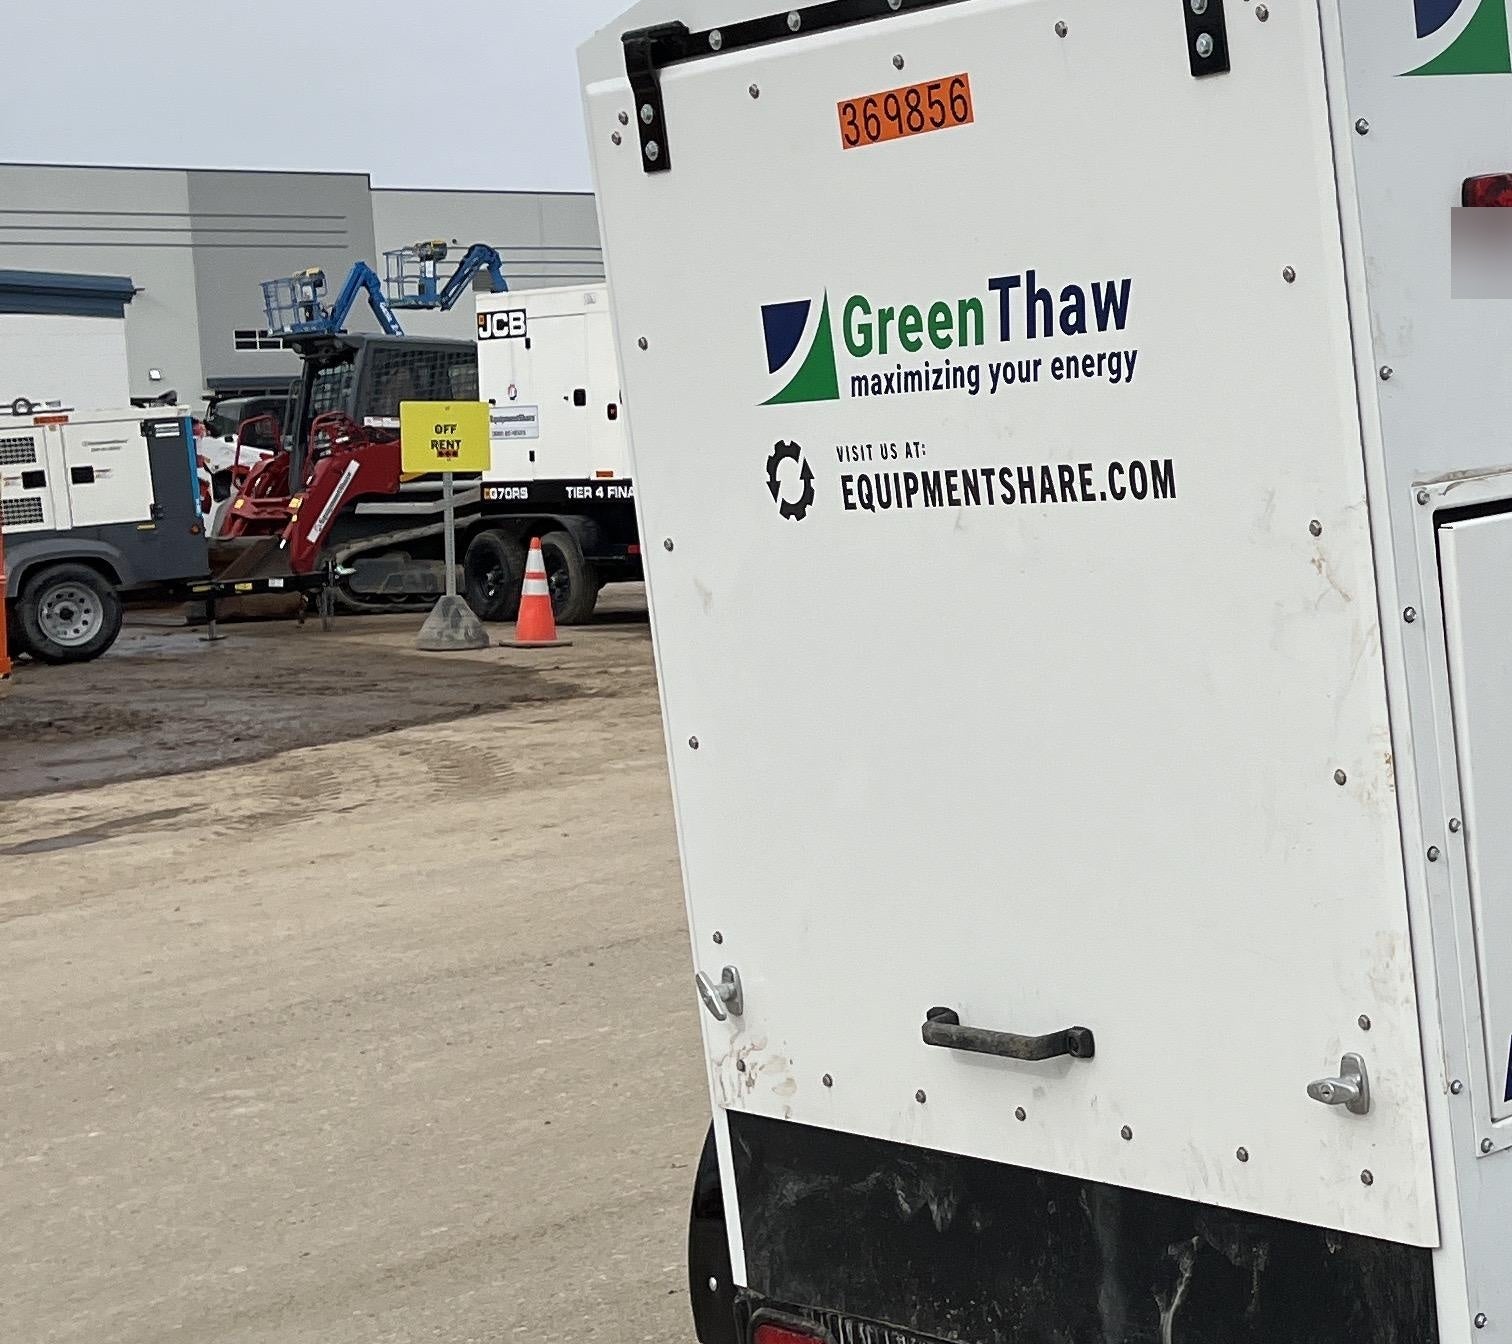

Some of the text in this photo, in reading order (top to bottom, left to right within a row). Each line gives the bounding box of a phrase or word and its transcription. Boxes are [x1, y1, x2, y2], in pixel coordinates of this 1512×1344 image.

[842, 77, 968, 146] 369856
[478, 310, 527, 339] JCB
[850, 349, 1138, 398] maximizing your energy
[434, 423, 458, 434] OFF
[430, 439, 462, 450] RENT
[836, 441, 927, 462] VISIT US AT:
[565, 486, 592, 499] TIER
[595, 486, 604, 498] 4
[841, 458, 1177, 513] EQUIPMENTSHARE.COM
